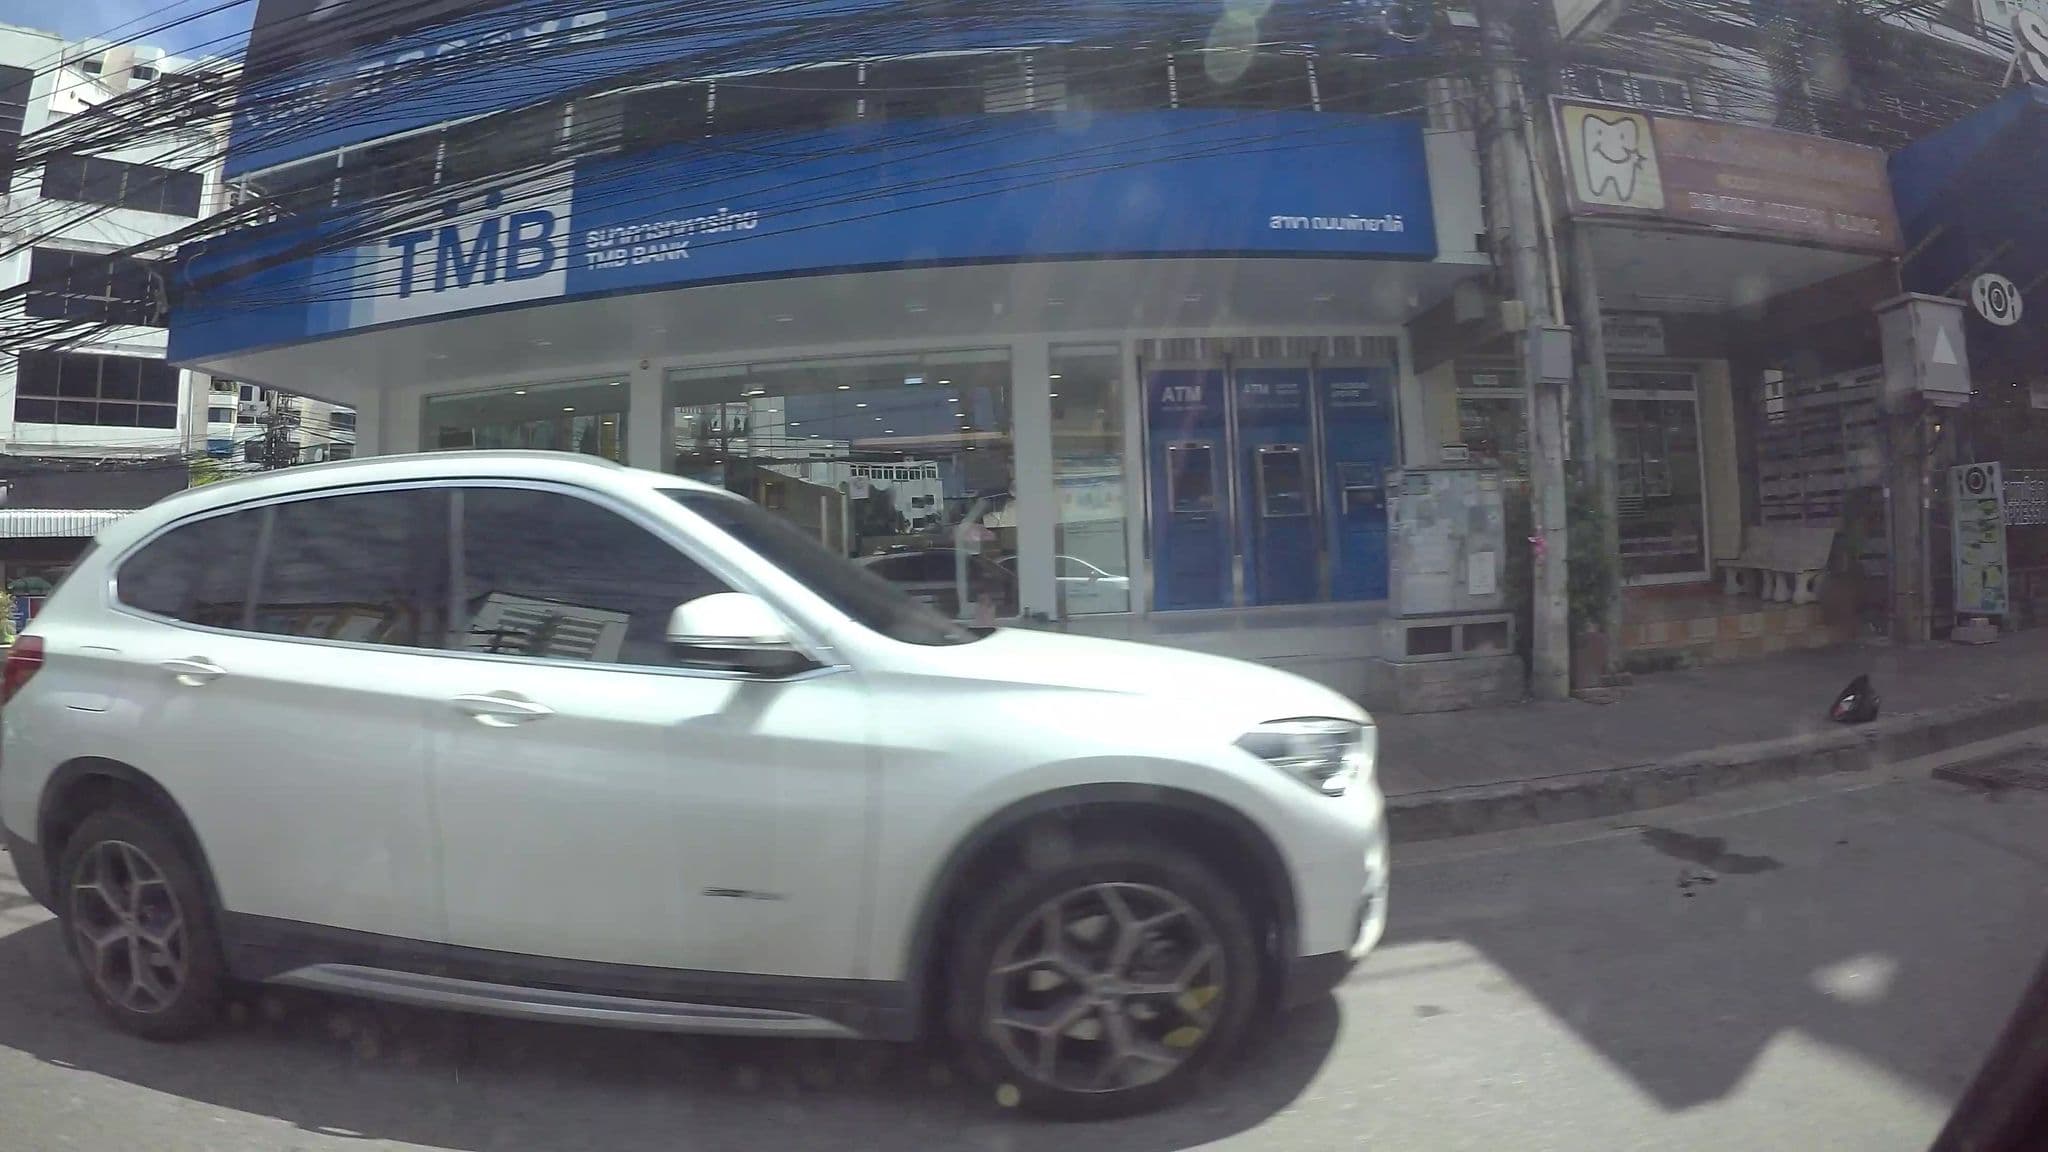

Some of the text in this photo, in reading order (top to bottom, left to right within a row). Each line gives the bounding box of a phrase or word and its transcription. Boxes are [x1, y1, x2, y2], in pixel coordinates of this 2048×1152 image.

[388, 208, 556, 300] TMB
[585, 240, 690, 271] TMB BANK
[1161, 386, 1202, 403] ATM
